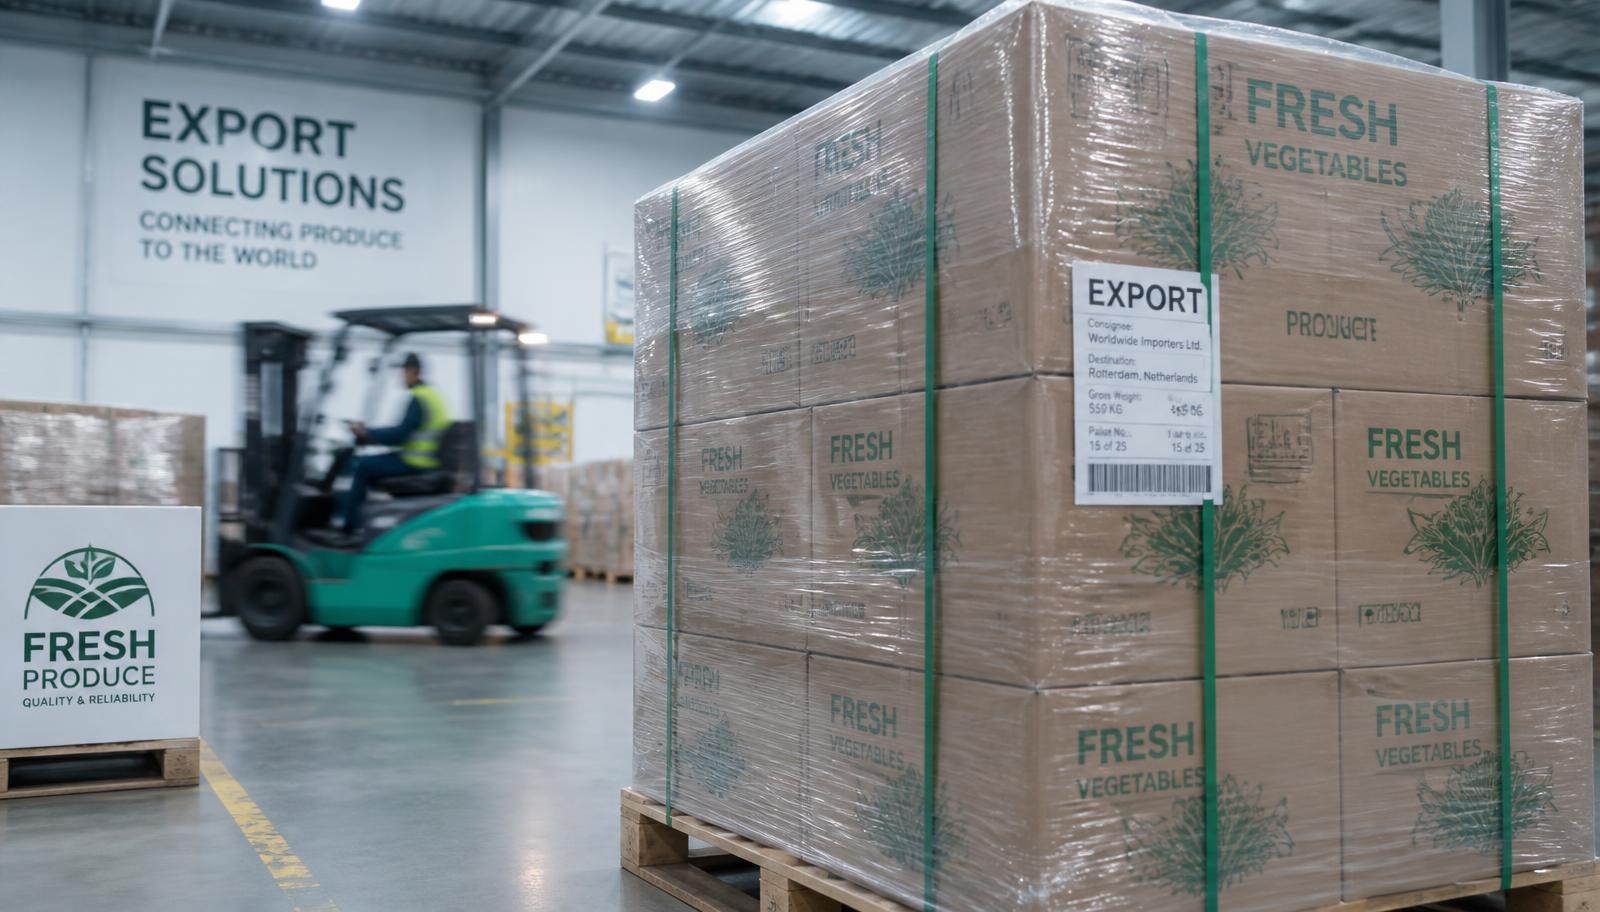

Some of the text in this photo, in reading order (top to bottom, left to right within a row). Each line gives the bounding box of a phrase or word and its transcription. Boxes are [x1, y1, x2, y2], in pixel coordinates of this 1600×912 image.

[142, 98, 356, 158] EXPORT
[1246, 78, 1398, 146] FRESH
[1244, 139, 1407, 187] VEGETABLES
[141, 154, 405, 212] SOLUTIONS
[140, 210, 403, 249] CONNECTING PRODUCE
[140, 239, 317, 269] TO THE WORLD
[1088, 278, 1202, 314] EXPORT
[1088, 333, 1203, 351] Worldwide Importers Ltd.
[1144, 371, 1198, 384] Netherlands
[701, 446, 742, 472] FRESH
[830, 430, 893, 463] FRESH
[1090, 440, 1101, 451] 15
[1367, 427, 1461, 461] FRESH
[830, 470, 900, 490] VEGETABLES
[1367, 470, 1470, 488] VEGETABLES
[24, 629, 155, 662] FRESH
[24, 666, 155, 690] PRODUCE
[23, 693, 155, 708] QUALITY & RELIABILITY
[830, 694, 897, 738] FRESH
[1376, 699, 1470, 737] FRESH
[830, 735, 904, 769] VEGETABLES
[1078, 721, 1194, 765] FRESH
[1376, 739, 1481, 768] VEGETABLES
[1077, 767, 1206, 799] VEGETABLES
